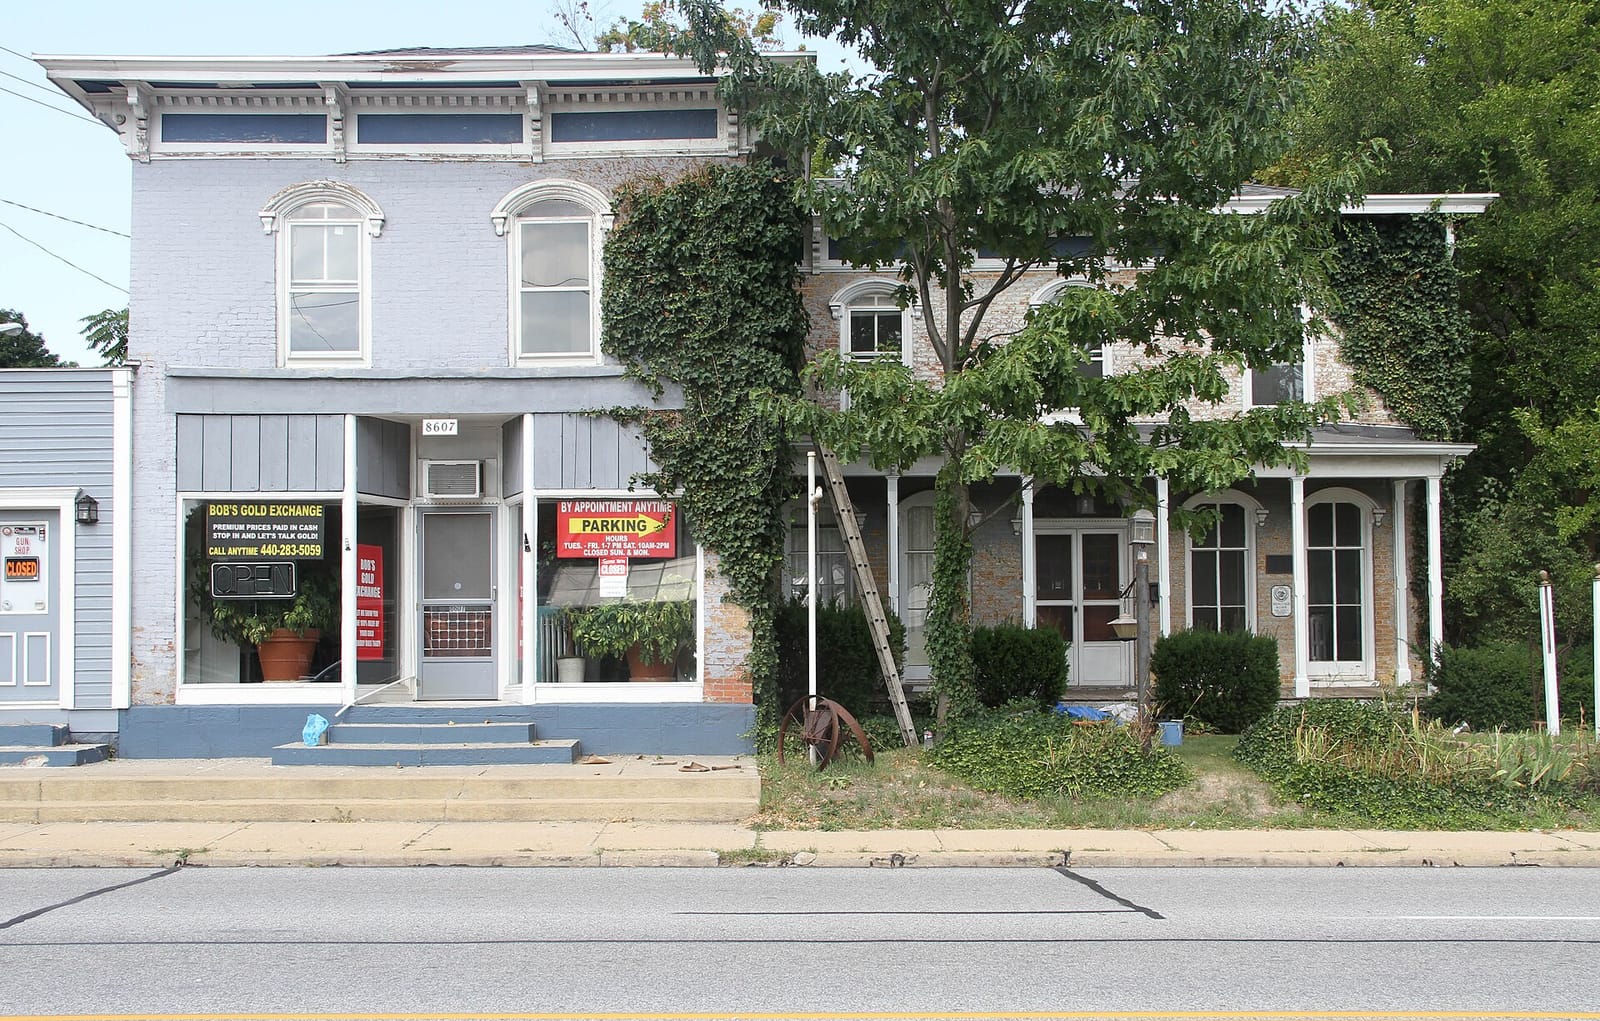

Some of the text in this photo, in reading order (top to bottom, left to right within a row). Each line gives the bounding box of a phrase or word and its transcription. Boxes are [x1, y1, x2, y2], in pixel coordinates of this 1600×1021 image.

[425, 422, 456, 433] 8607
[209, 504, 323, 517] BOB'S GOLD EXCHANGE
[561, 501, 672, 513] BY APPOINTMENT ANYTIME
[582, 519, 647, 532] PARKING
[212, 532, 318, 540] STOP IN AND LET'S TALK GOLD!
[208, 544, 321, 556] CALL ANYTIME 440-283-5059
[7, 561, 37, 577] CLOSED
[601, 564, 626, 575] CLOSED
[215, 565, 292, 594] OPEN
